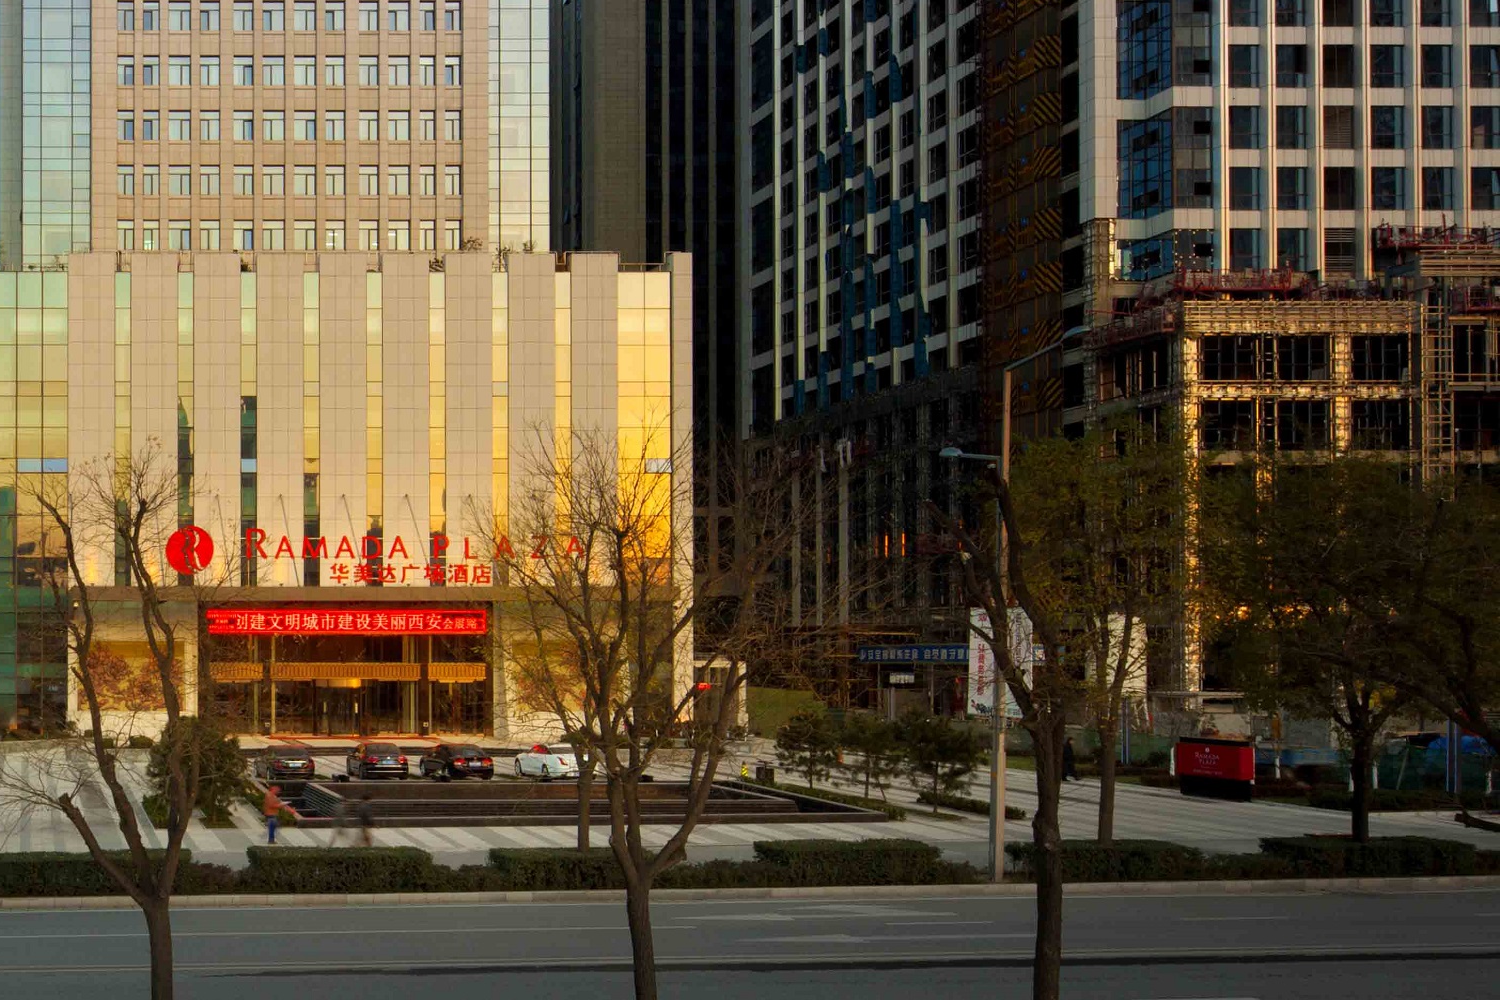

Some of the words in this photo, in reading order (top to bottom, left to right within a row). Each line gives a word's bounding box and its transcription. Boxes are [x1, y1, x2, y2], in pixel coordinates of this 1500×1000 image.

[245, 527, 409, 560] RAMADA
[432, 534, 585, 560] PLAZA
[329, 563, 492, 584] 华美达广场酒店
